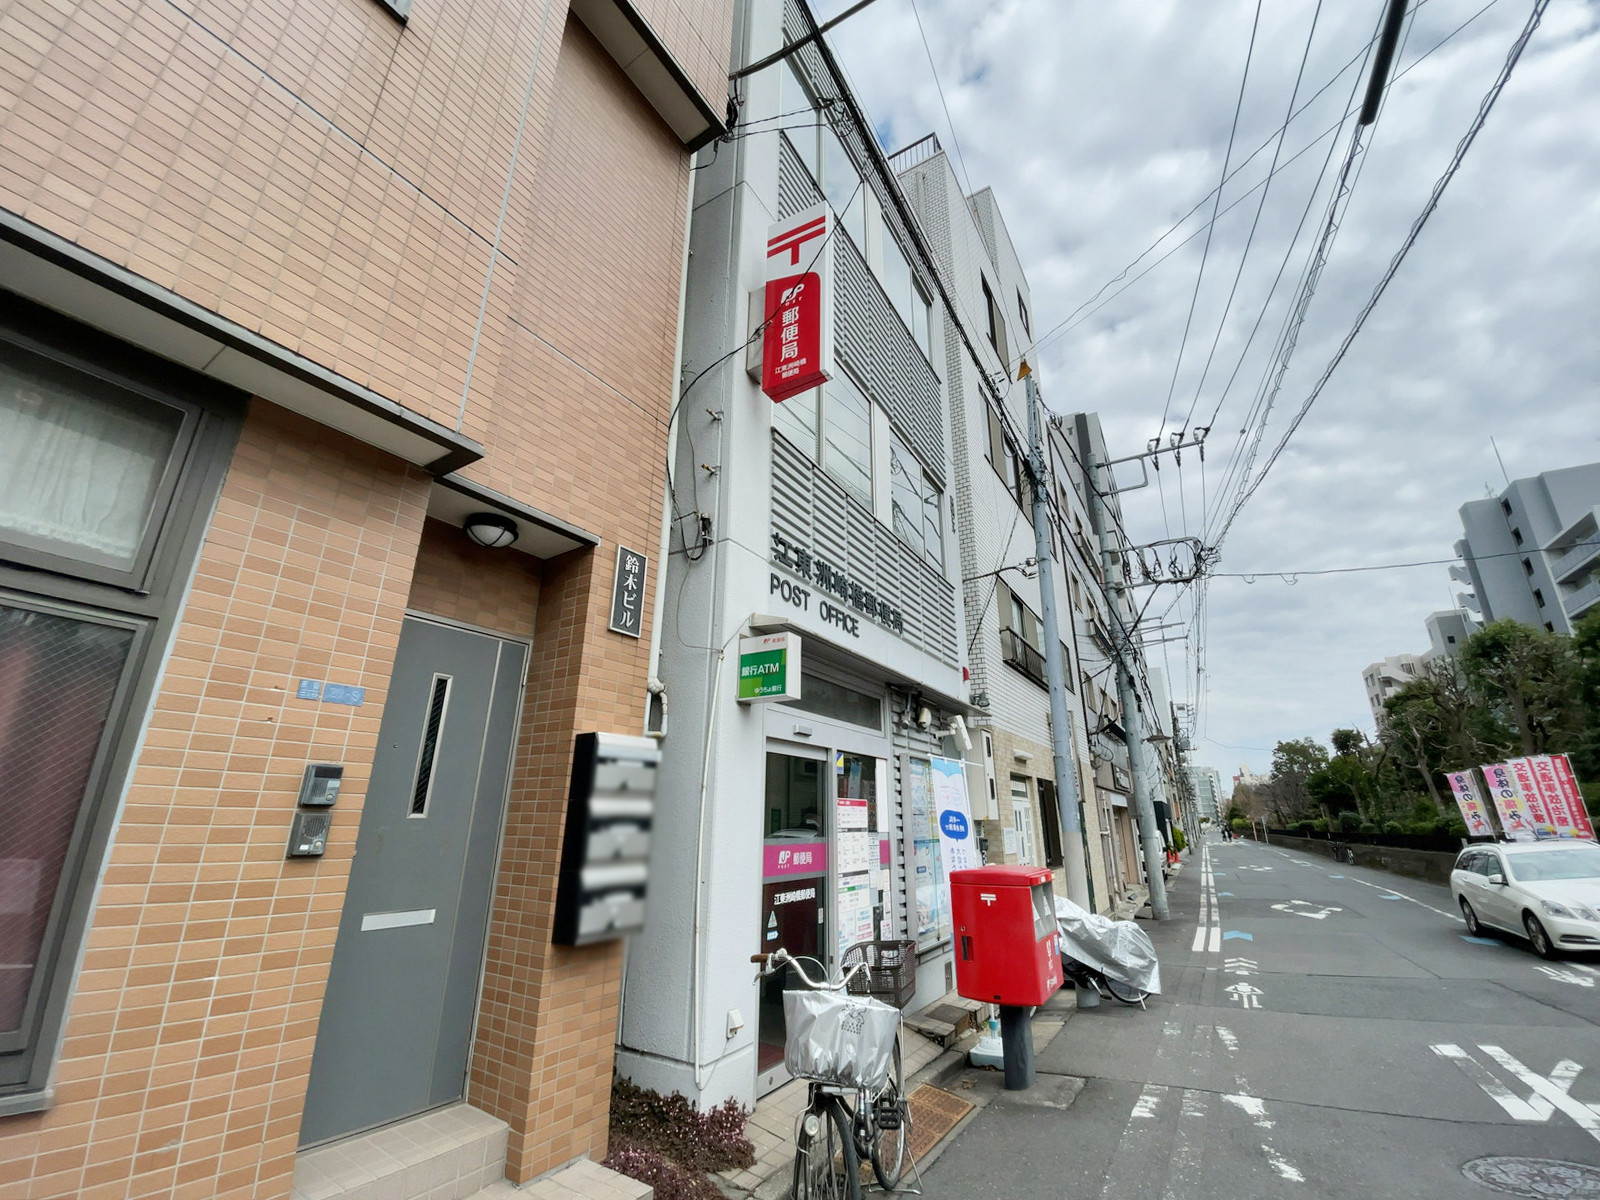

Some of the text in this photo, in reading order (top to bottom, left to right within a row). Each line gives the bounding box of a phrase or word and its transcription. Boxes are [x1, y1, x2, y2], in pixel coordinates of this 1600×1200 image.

[780, 306, 800, 362] 郵便局
[619, 554, 640, 628] 鈴木ビル
[770, 572, 860, 638] POST OFFICE
[771, 532, 904, 634] 江東洲崎橋郵便局
[741, 662, 779, 677] 銀行ATM
[753, 684, 782, 694] ゆうちょ銀行
[792, 851, 813, 866] 郵便局
